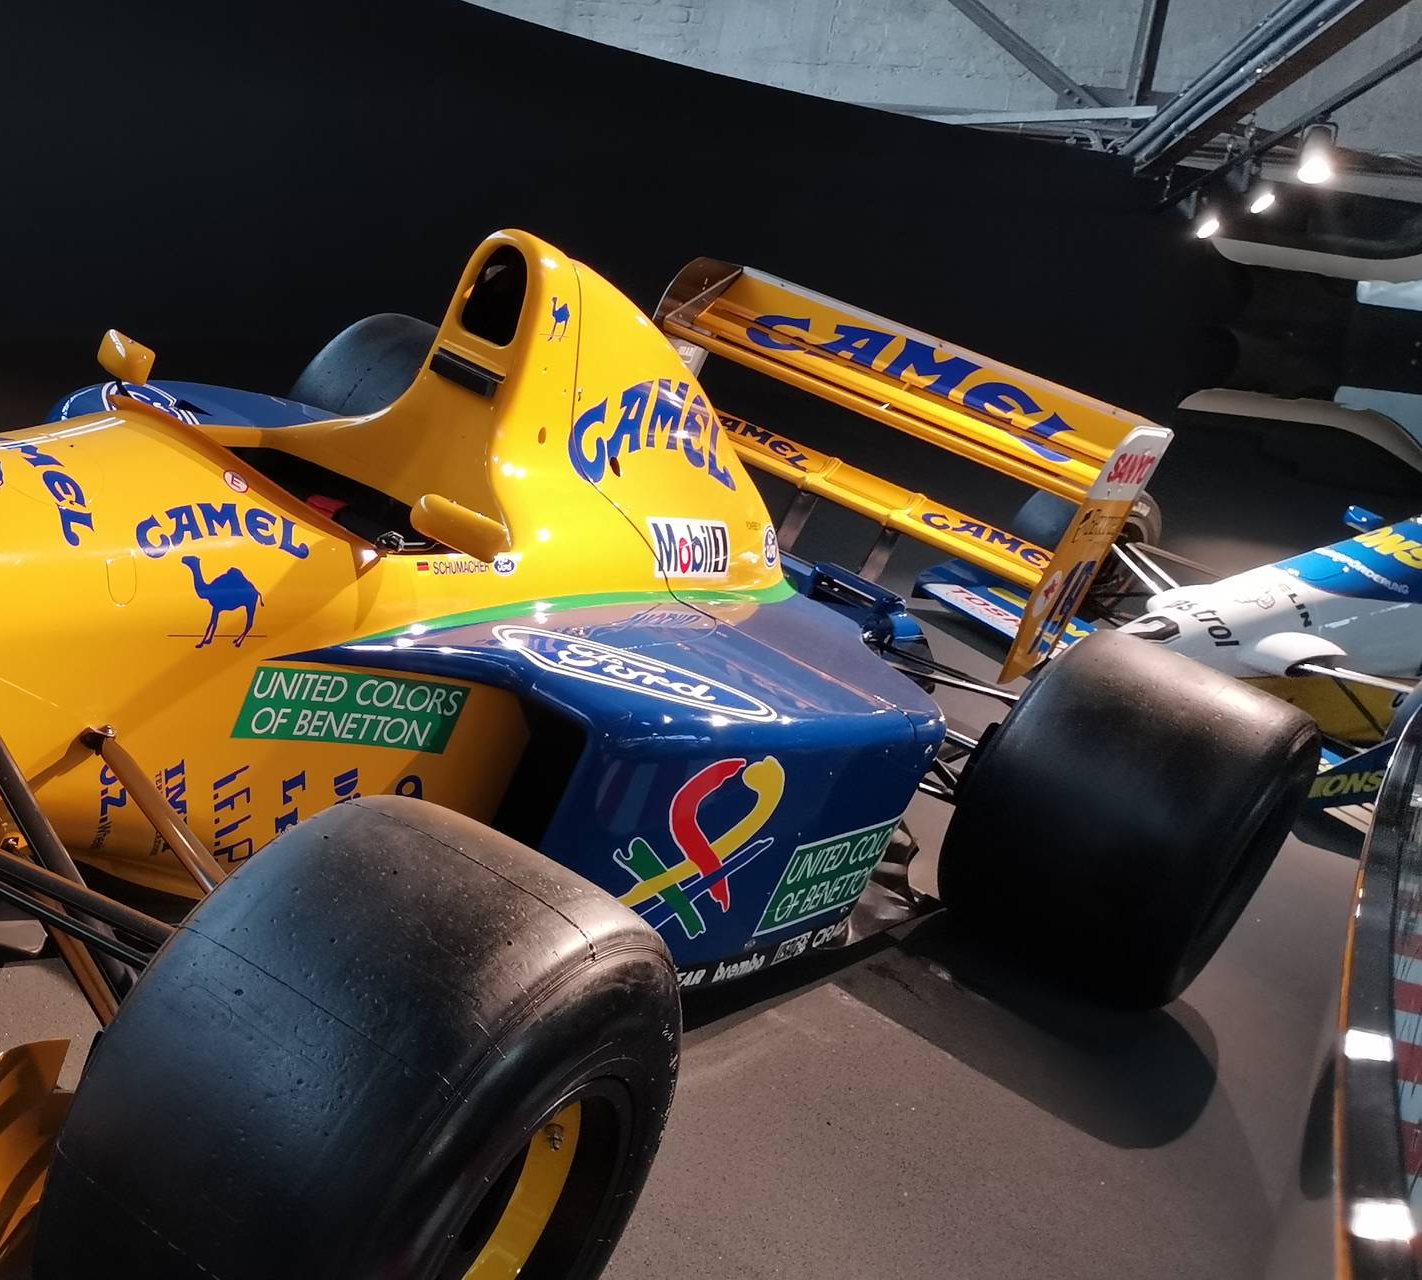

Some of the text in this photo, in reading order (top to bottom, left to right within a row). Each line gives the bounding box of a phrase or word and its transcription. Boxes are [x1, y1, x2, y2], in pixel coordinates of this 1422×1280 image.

[746, 315, 1077, 462] CAMEL
[568, 379, 736, 491] CAMEL
[718, 414, 809, 472] AMEL
[135, 502, 310, 558] CAMEL
[651, 522, 712, 574] Mobil
[921, 513, 1051, 568] CAME
[433, 560, 490, 575] SCHUMACHER
[253, 671, 464, 717] UNITED COLORS
[251, 707, 433, 747] OF BENETTON
[786, 841, 851, 885] UNITED
[774, 888, 806, 922] OF
[712, 952, 766, 983] brembo
